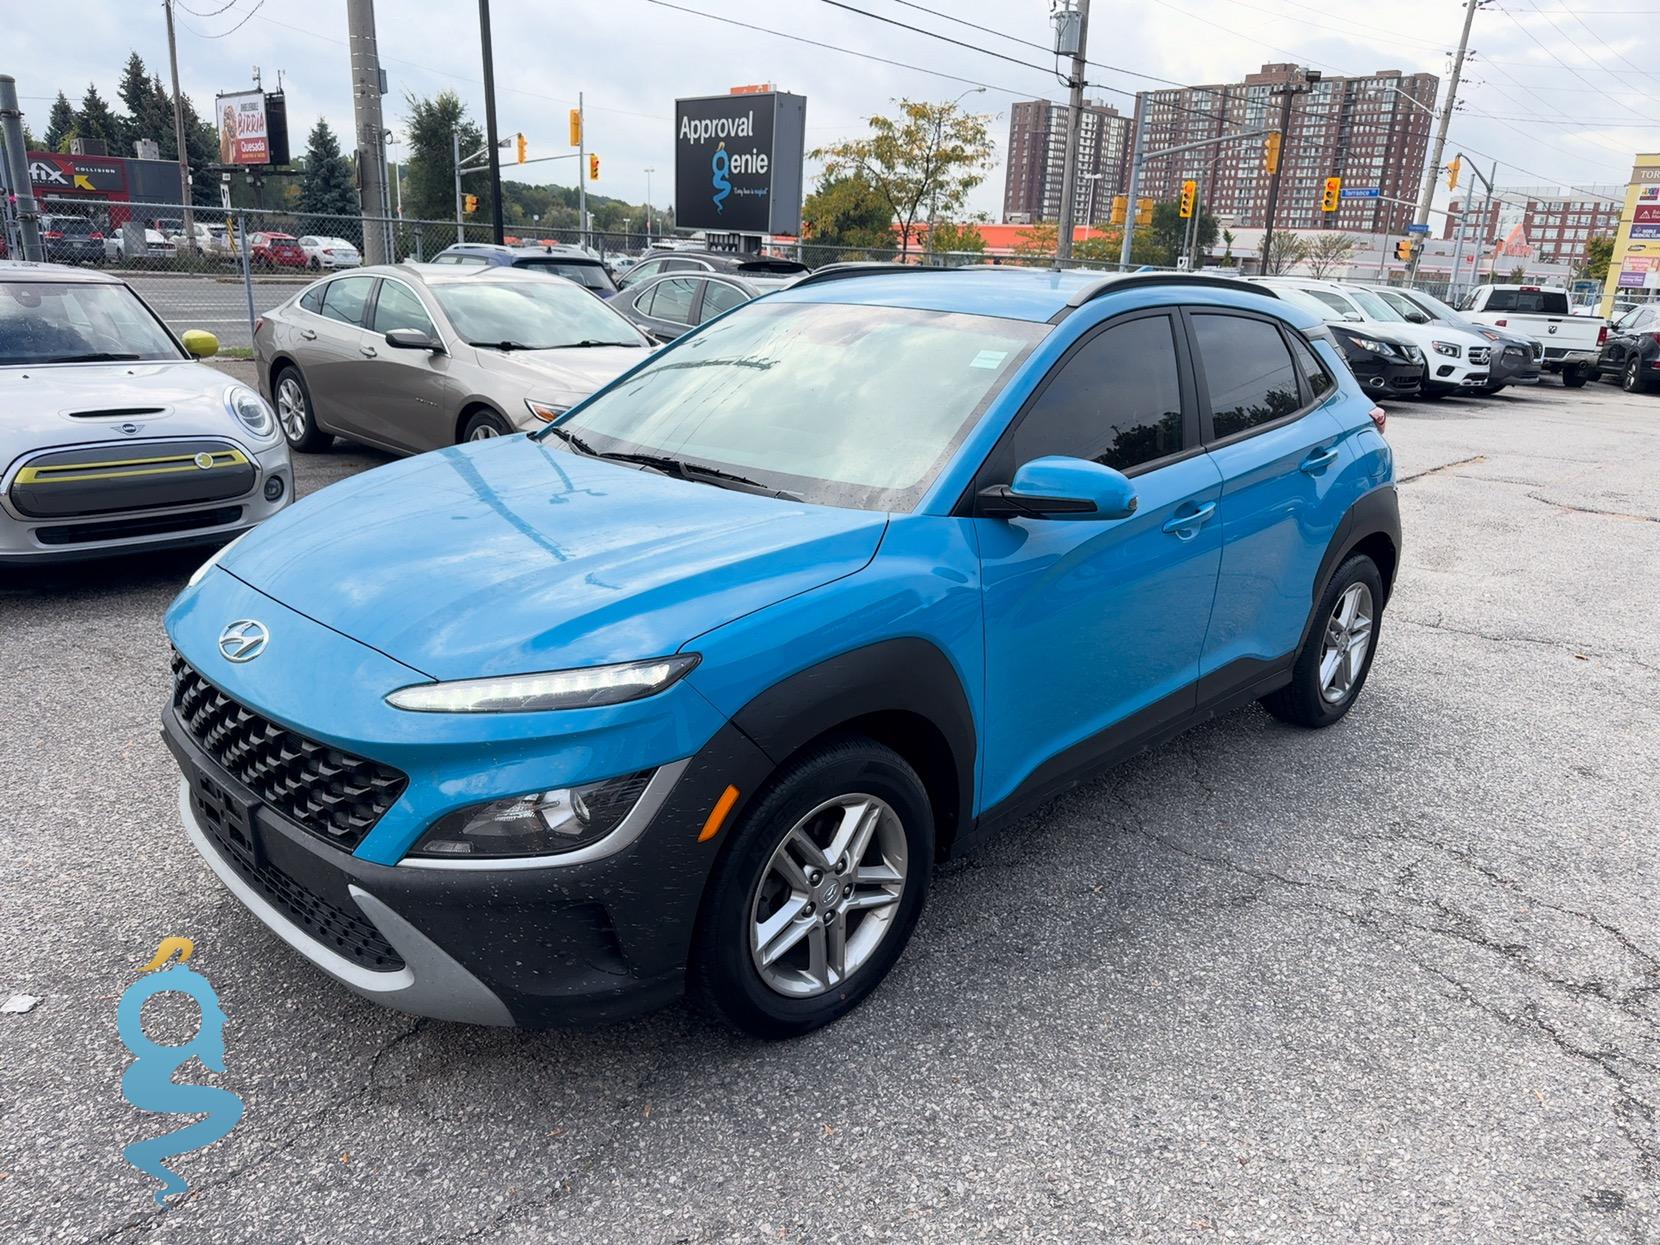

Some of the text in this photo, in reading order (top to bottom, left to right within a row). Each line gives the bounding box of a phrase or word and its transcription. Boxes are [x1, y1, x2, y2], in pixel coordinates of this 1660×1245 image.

[679, 110, 753, 145] Approval
[241, 140, 265, 152] Quesada
[75, 166, 116, 174] COLLISION
